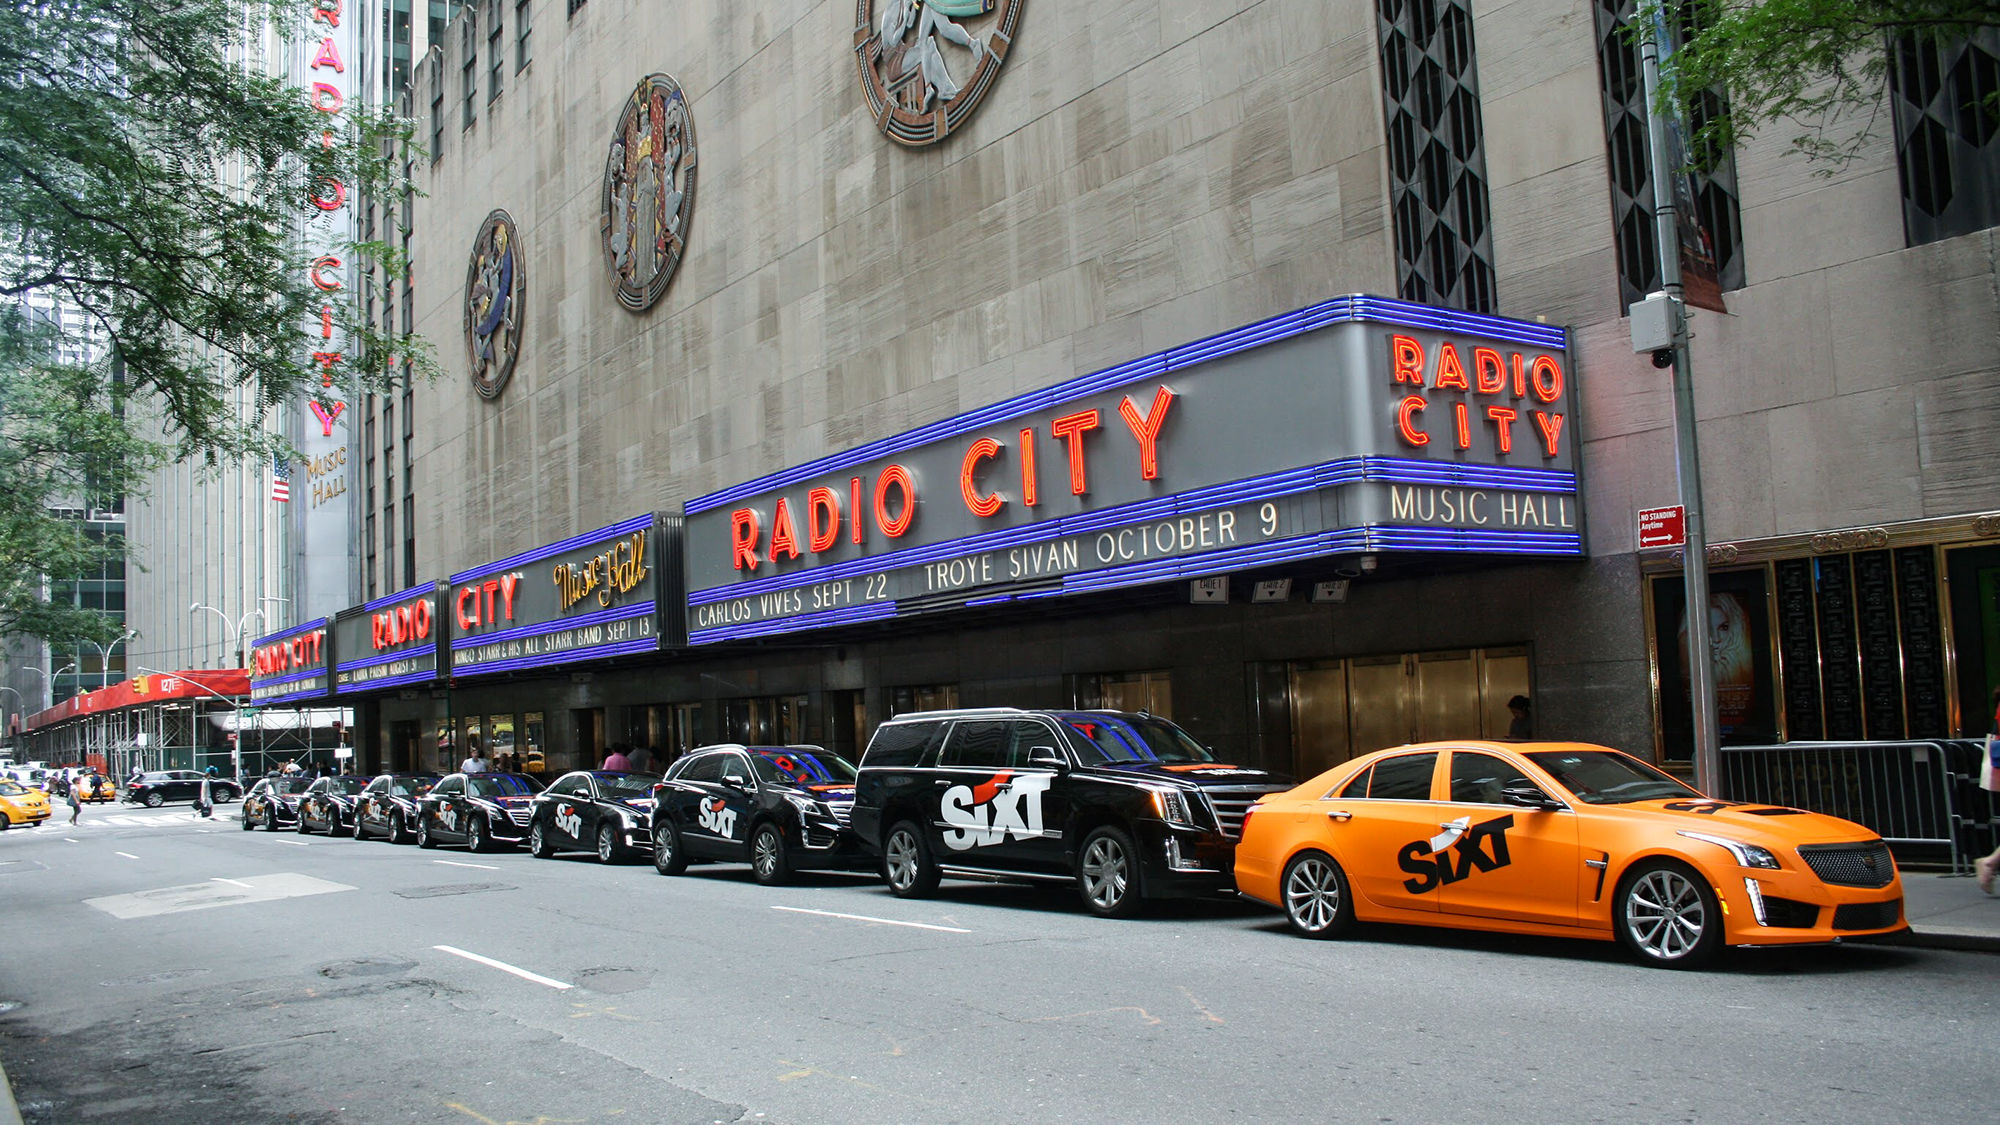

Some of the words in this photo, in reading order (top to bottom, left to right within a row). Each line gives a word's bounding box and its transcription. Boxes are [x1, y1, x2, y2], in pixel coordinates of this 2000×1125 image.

[309, 255, 346, 437] CITY
[1392, 334, 1563, 403] RADIO
[1398, 395, 1563, 456] CITY
[306, 447, 347, 483] MUSIC
[731, 464, 915, 571] RADIO
[961, 384, 1177, 517] CITY
[312, 475, 347, 509] HALL
[1391, 485, 1488, 525] MUSIC
[1500, 493, 1573, 528] HALL
[1650, 510, 1677, 520] STANDING
[924, 554, 992, 591] TROYE
[1010, 538, 1078, 578] SIVAN
[1096, 510, 1236, 563] OCTOBER
[1260, 502, 1277, 536] 9
[1641, 522, 1664, 531] Anytime
[372, 598, 431, 650] RADIO
[456, 572, 519, 630] CITY
[698, 598, 752, 627] CARLOS
[760, 589, 802, 617] VIVES
[813, 579, 852, 609] SEPT
[865, 573, 888, 600] 22
[291, 631, 322, 668] CITY
[454, 650, 475, 665] RINGO
[478, 646, 500, 661] STARR
[508, 643, 521, 657] HIS
[524, 639, 540, 655] ALL
[545, 631, 573, 652] STARR
[577, 626, 602, 646] BAND
[607, 620, 632, 641] SEPT
[639, 617, 650, 636] 13
